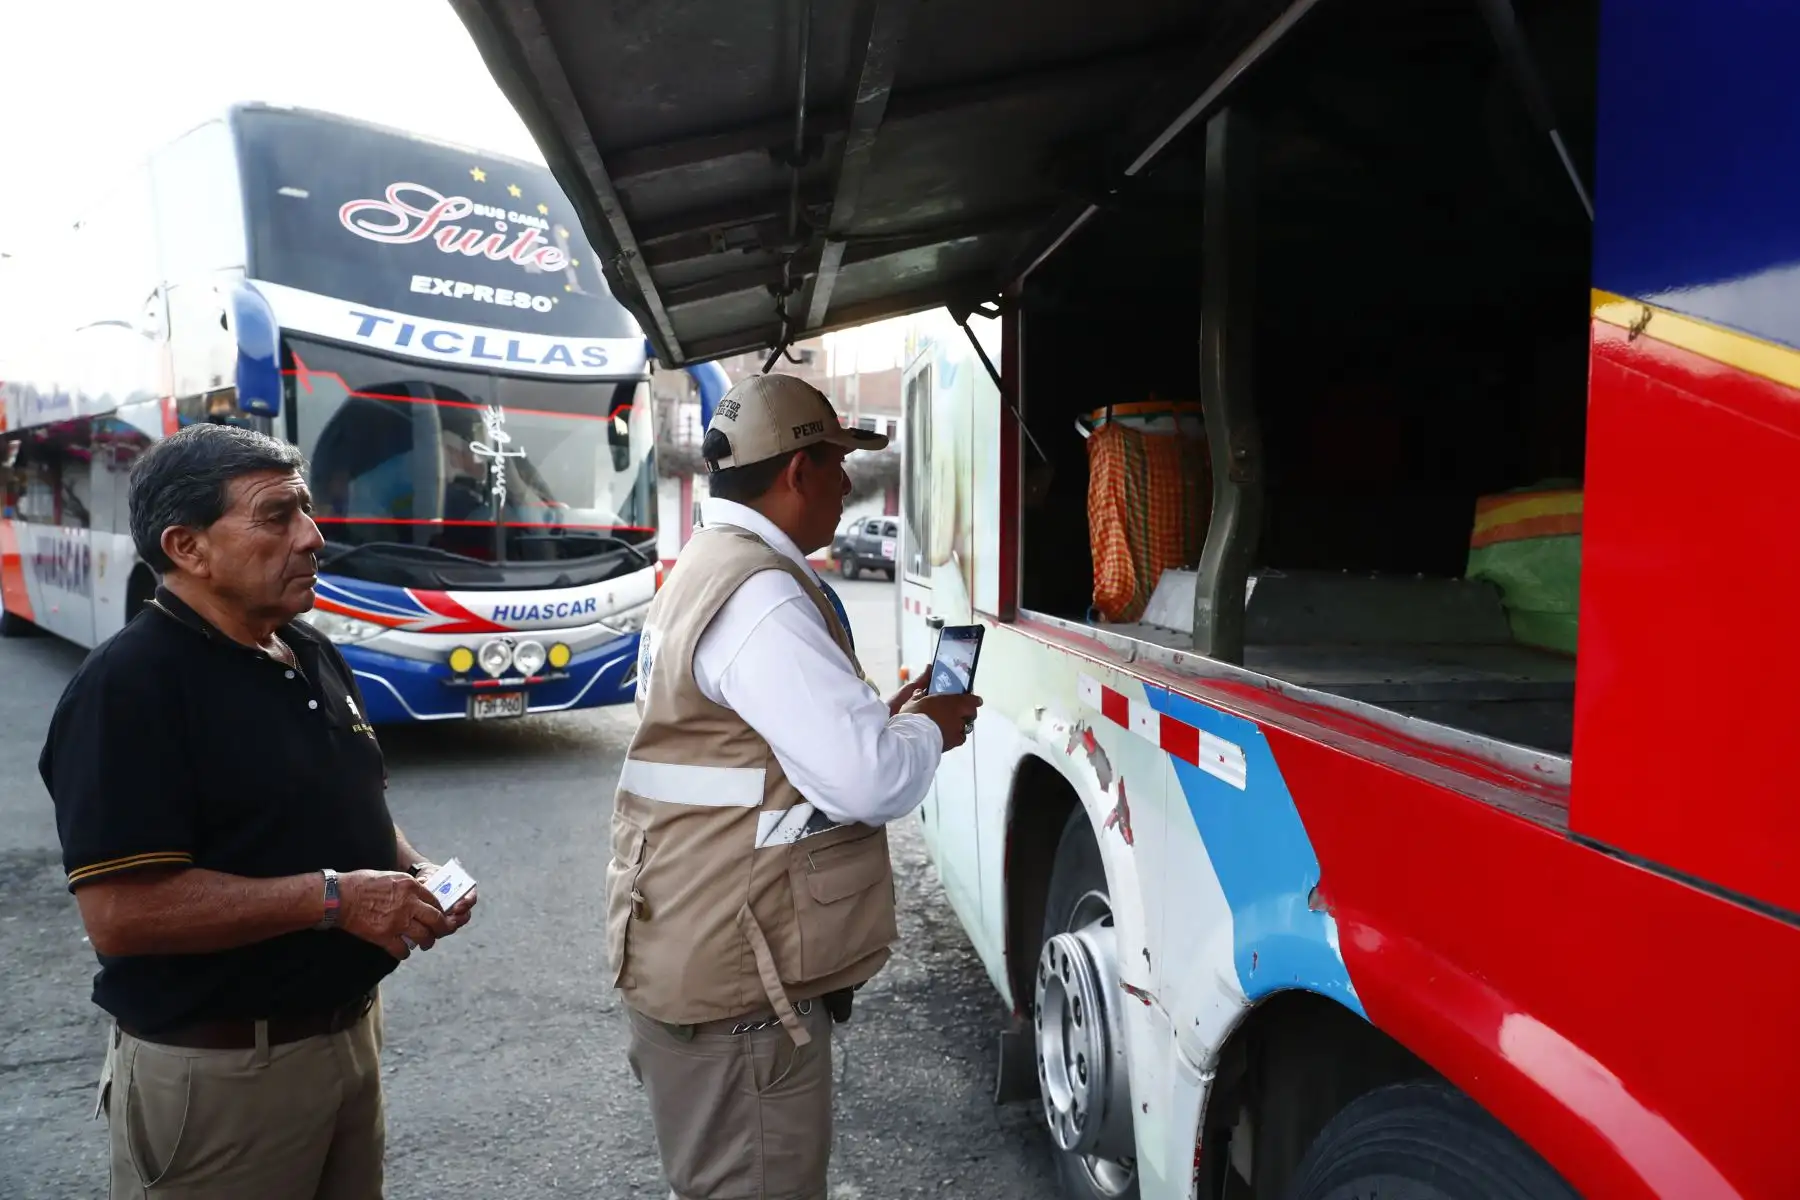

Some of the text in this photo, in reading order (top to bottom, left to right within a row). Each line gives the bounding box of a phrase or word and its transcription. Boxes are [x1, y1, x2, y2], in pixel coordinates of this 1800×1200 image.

[339, 182, 569, 272] Suite
[473, 203, 506, 220] BUS
[410, 275, 553, 313] EXPRESO
[348, 310, 610, 369] TICLLAS
[792, 419, 825, 440] PERU
[491, 597, 597, 622] HUASCAR
